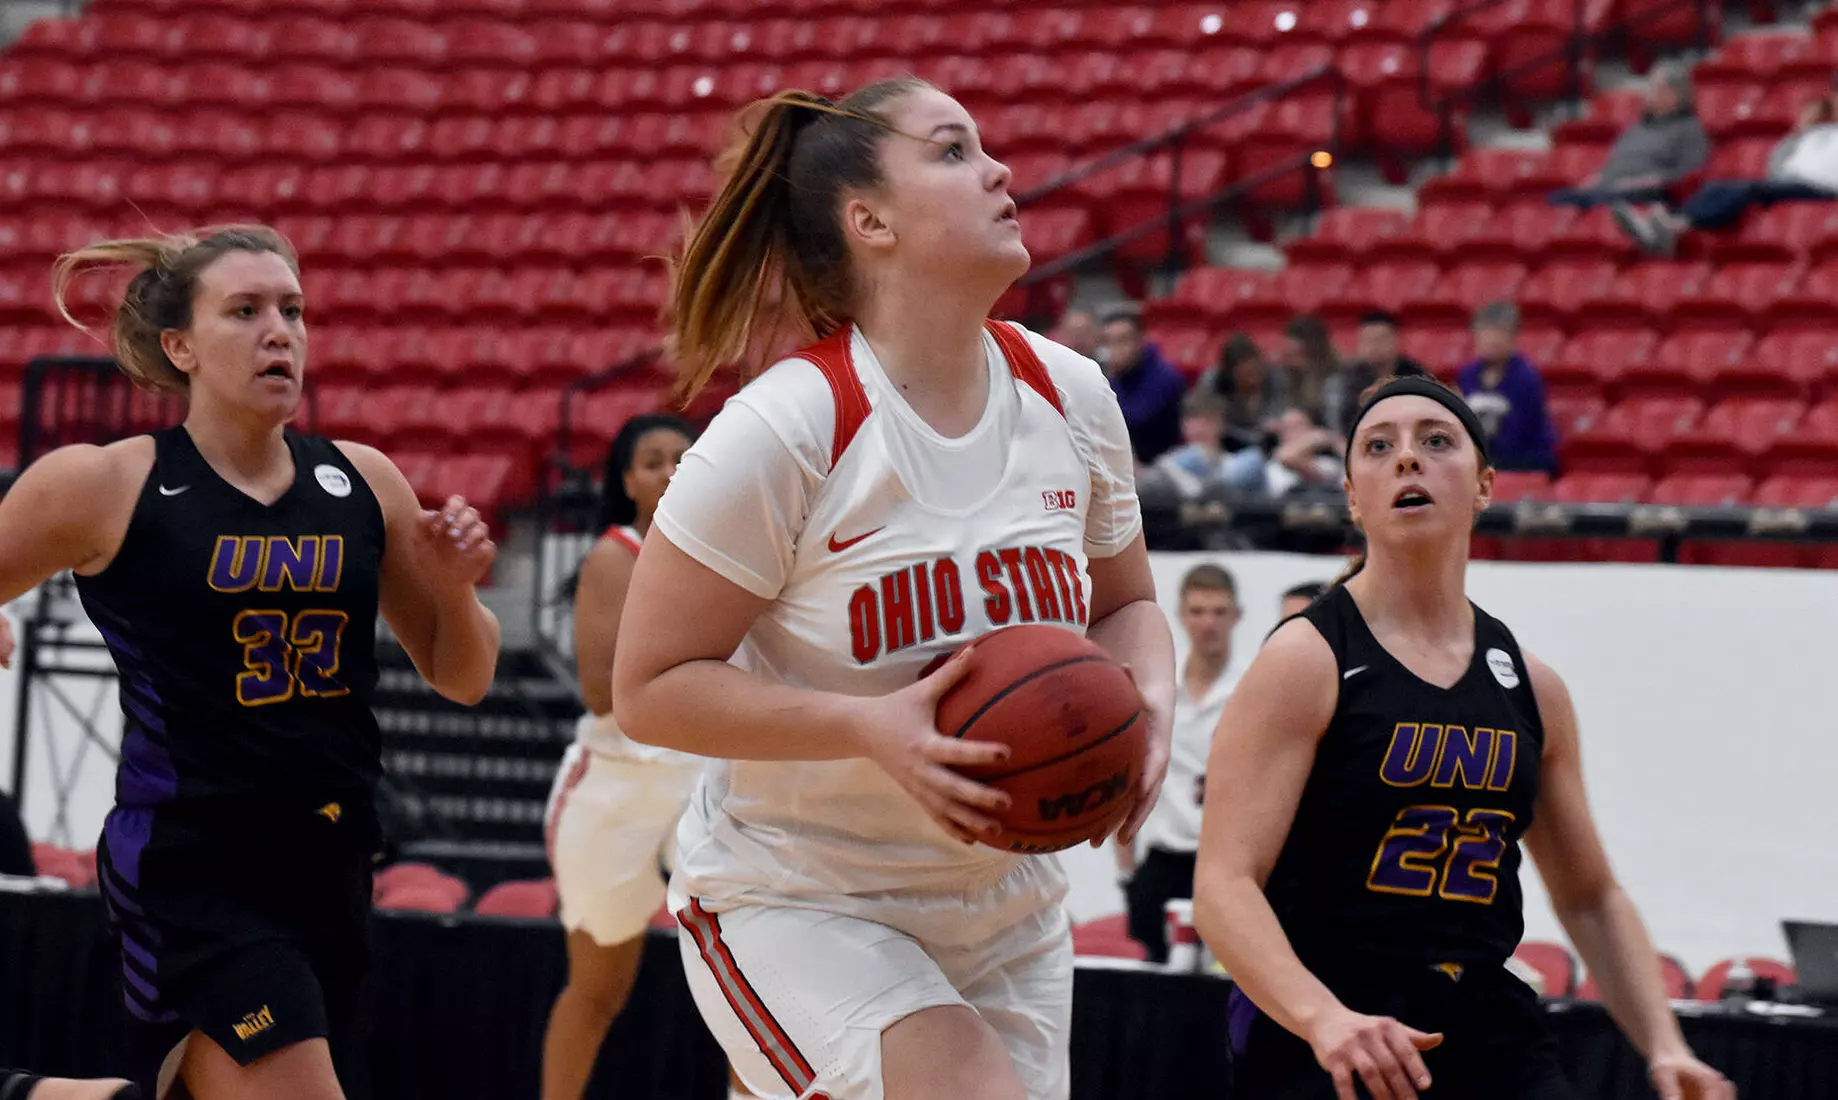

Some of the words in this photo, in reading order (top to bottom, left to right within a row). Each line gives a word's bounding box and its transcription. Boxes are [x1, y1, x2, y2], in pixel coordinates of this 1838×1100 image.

[207, 535, 343, 593] UNI
[848, 556, 966, 665] OHIO
[975, 545, 1087, 627] STATE
[232, 609, 350, 707] 32
[1379, 722, 1517, 792] UNI
[1366, 805, 1516, 904] 22
